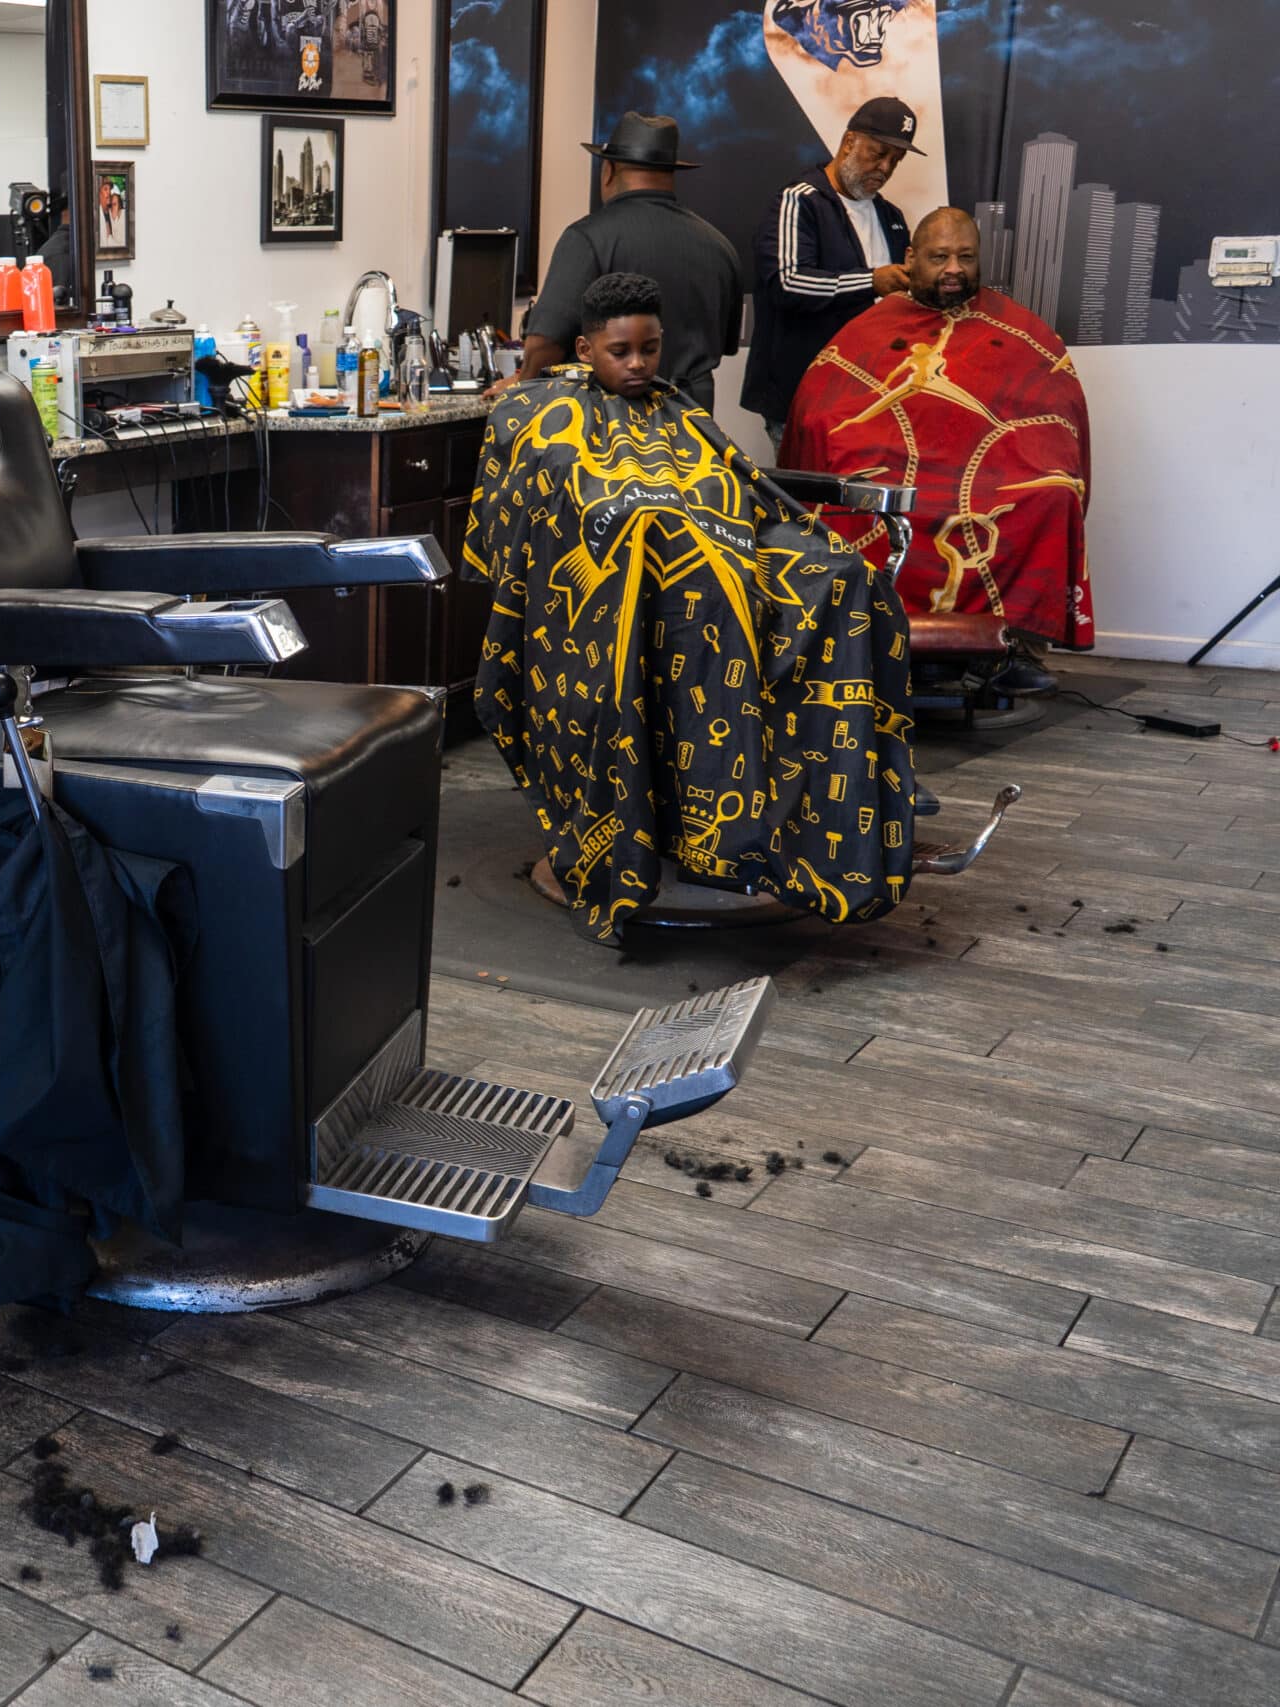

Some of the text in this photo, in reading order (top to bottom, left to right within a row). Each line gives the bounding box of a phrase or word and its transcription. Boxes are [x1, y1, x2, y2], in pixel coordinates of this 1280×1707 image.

[593, 504, 619, 536] Cut
[623, 486, 682, 508] Above
[714, 523, 754, 551] Rest
